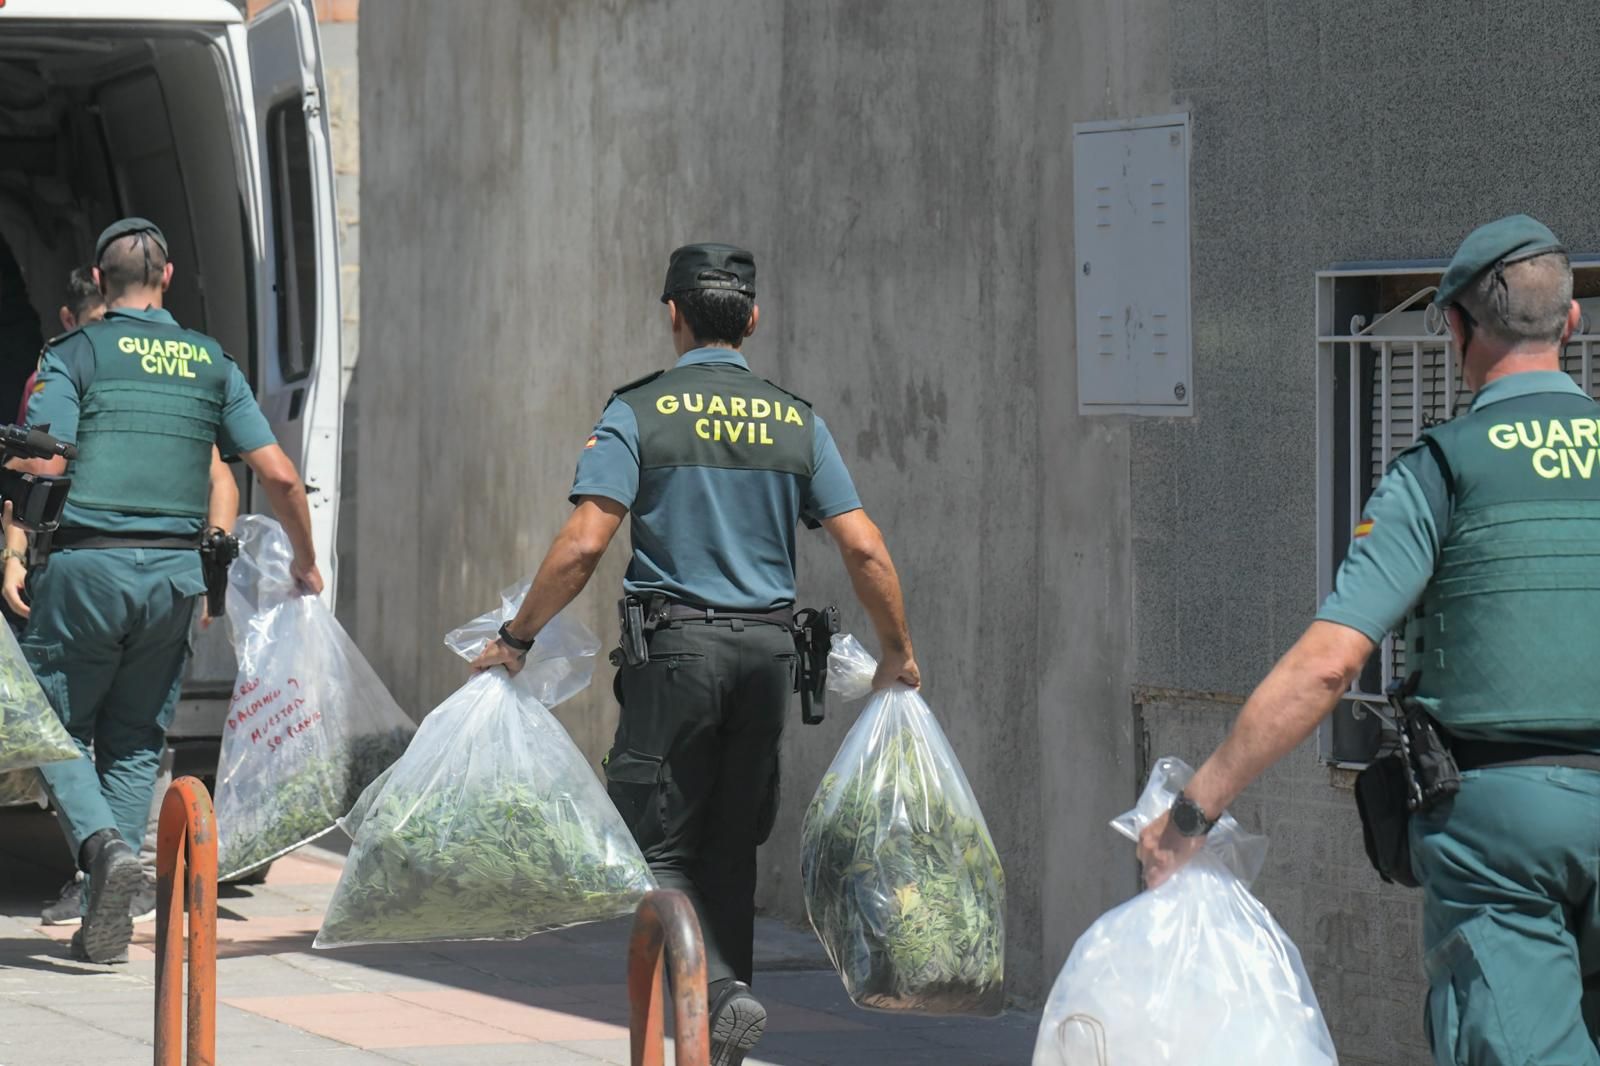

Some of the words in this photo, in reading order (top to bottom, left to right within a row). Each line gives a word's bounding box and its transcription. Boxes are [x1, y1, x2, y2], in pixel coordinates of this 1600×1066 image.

[118, 336, 212, 365] GUARDIA
[141, 354, 196, 378] CIVIL
[655, 393, 804, 426] GUARDIA
[695, 418, 774, 445] CIVIL
[1488, 418, 1600, 450] GUAR
